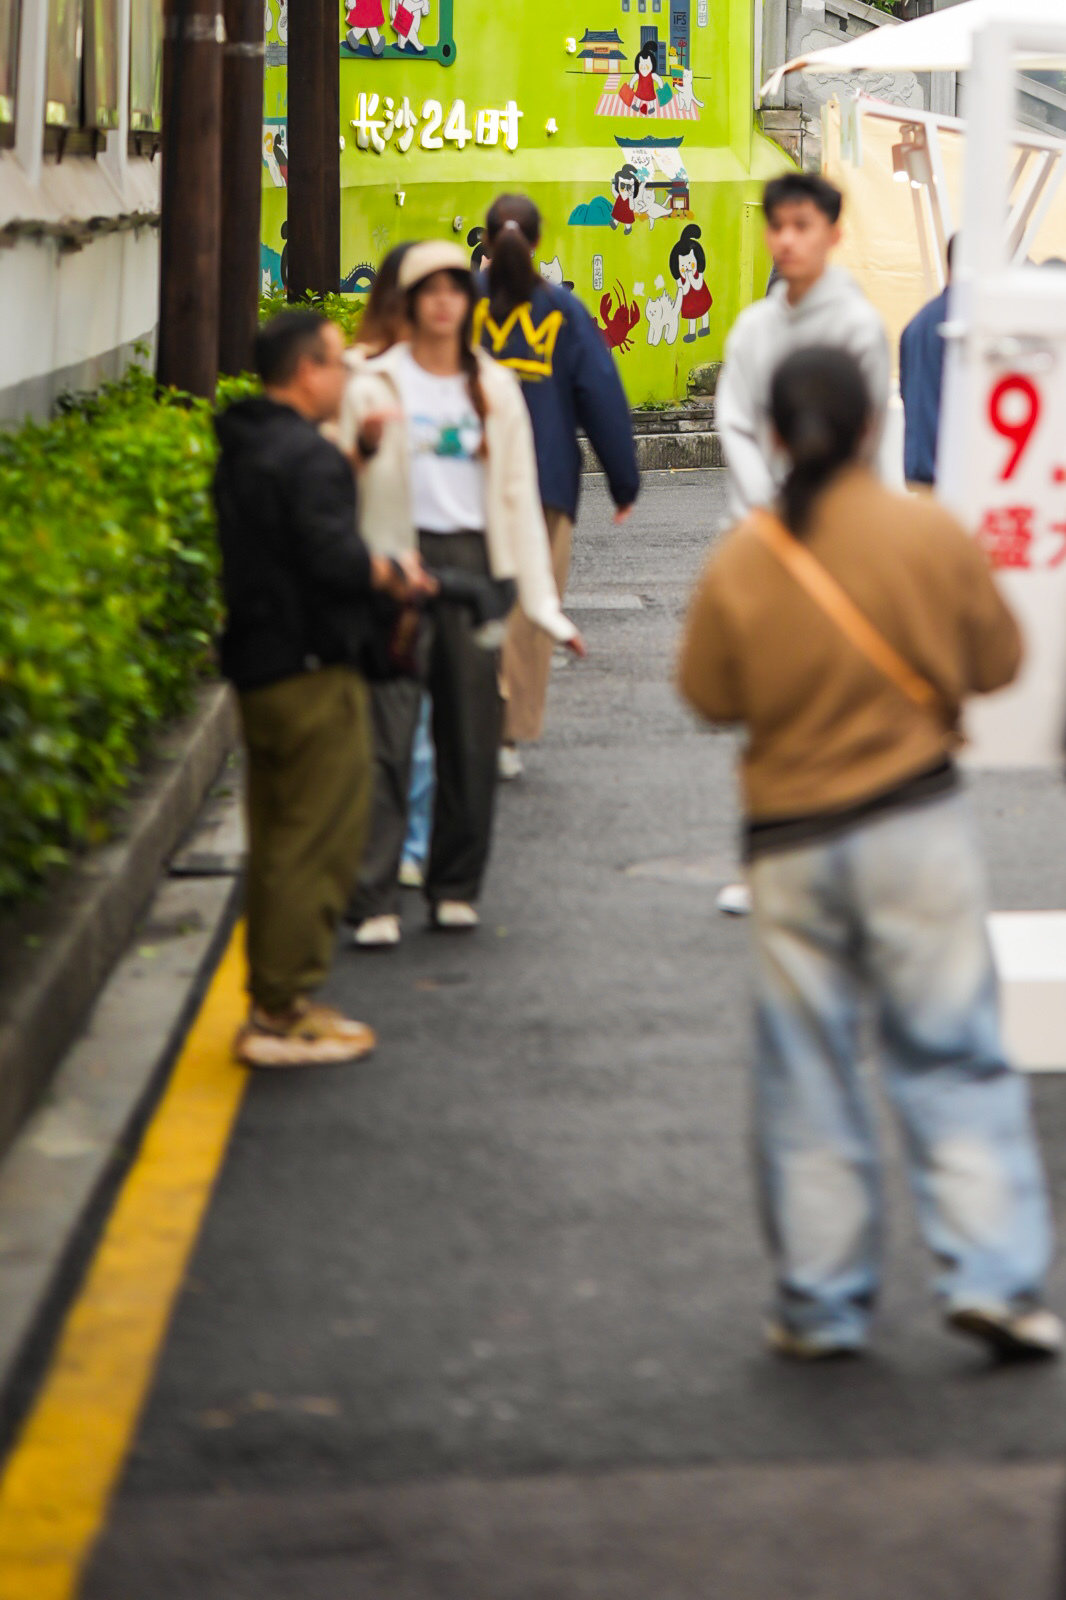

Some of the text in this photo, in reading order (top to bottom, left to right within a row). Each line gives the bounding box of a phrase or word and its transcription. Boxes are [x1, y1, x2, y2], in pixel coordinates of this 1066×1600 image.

[673, 14, 687, 26] IFS
[565, 37, 576, 53] 3
[351, 92, 523, 152] 长沙24时
[545, 118, 558, 134] 4
[396, 192, 406, 206] 7
